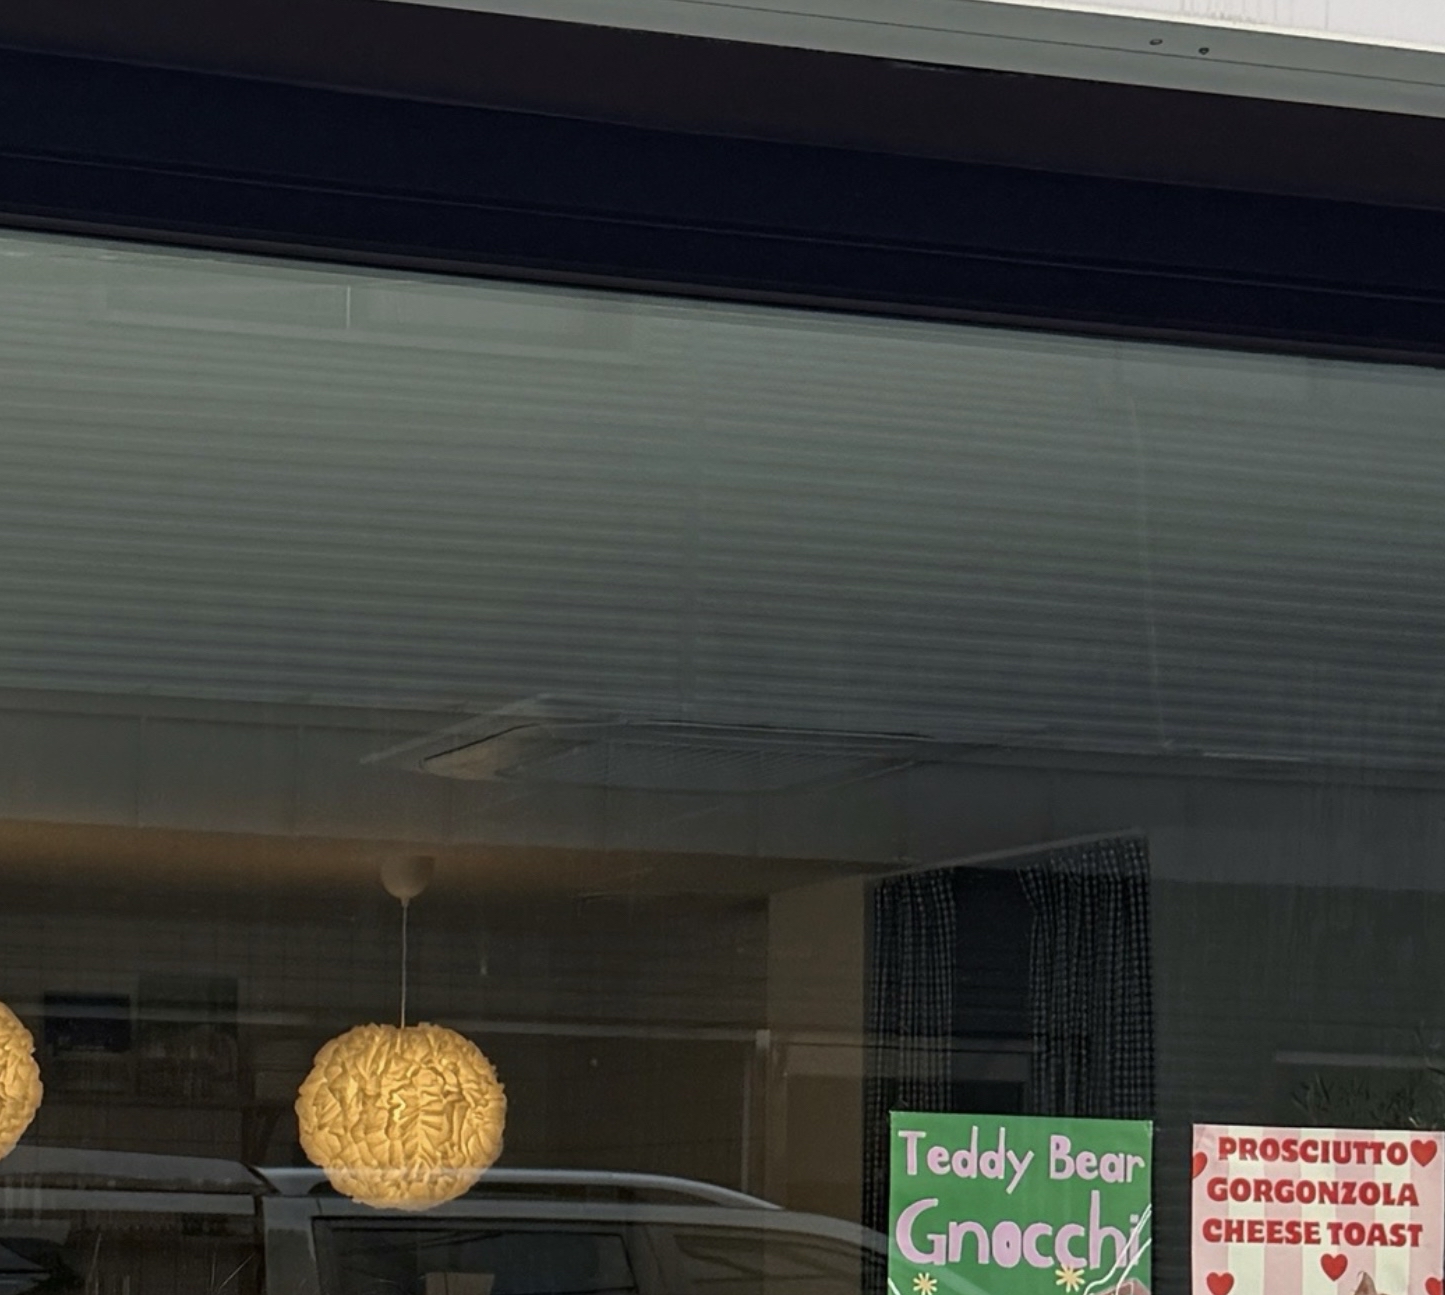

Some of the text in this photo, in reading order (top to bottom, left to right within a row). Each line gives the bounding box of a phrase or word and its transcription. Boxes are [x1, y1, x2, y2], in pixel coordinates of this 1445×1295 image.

[897, 1125, 1146, 1195] Teddy Bear
[1217, 1136, 1409, 1166] PROSCIUTTO
[1206, 1177, 1420, 1207] GORGONZOLA
[895, 1189, 1141, 1270] Gnocchi
[1202, 1218, 1424, 1248] CHEESE TOAST
